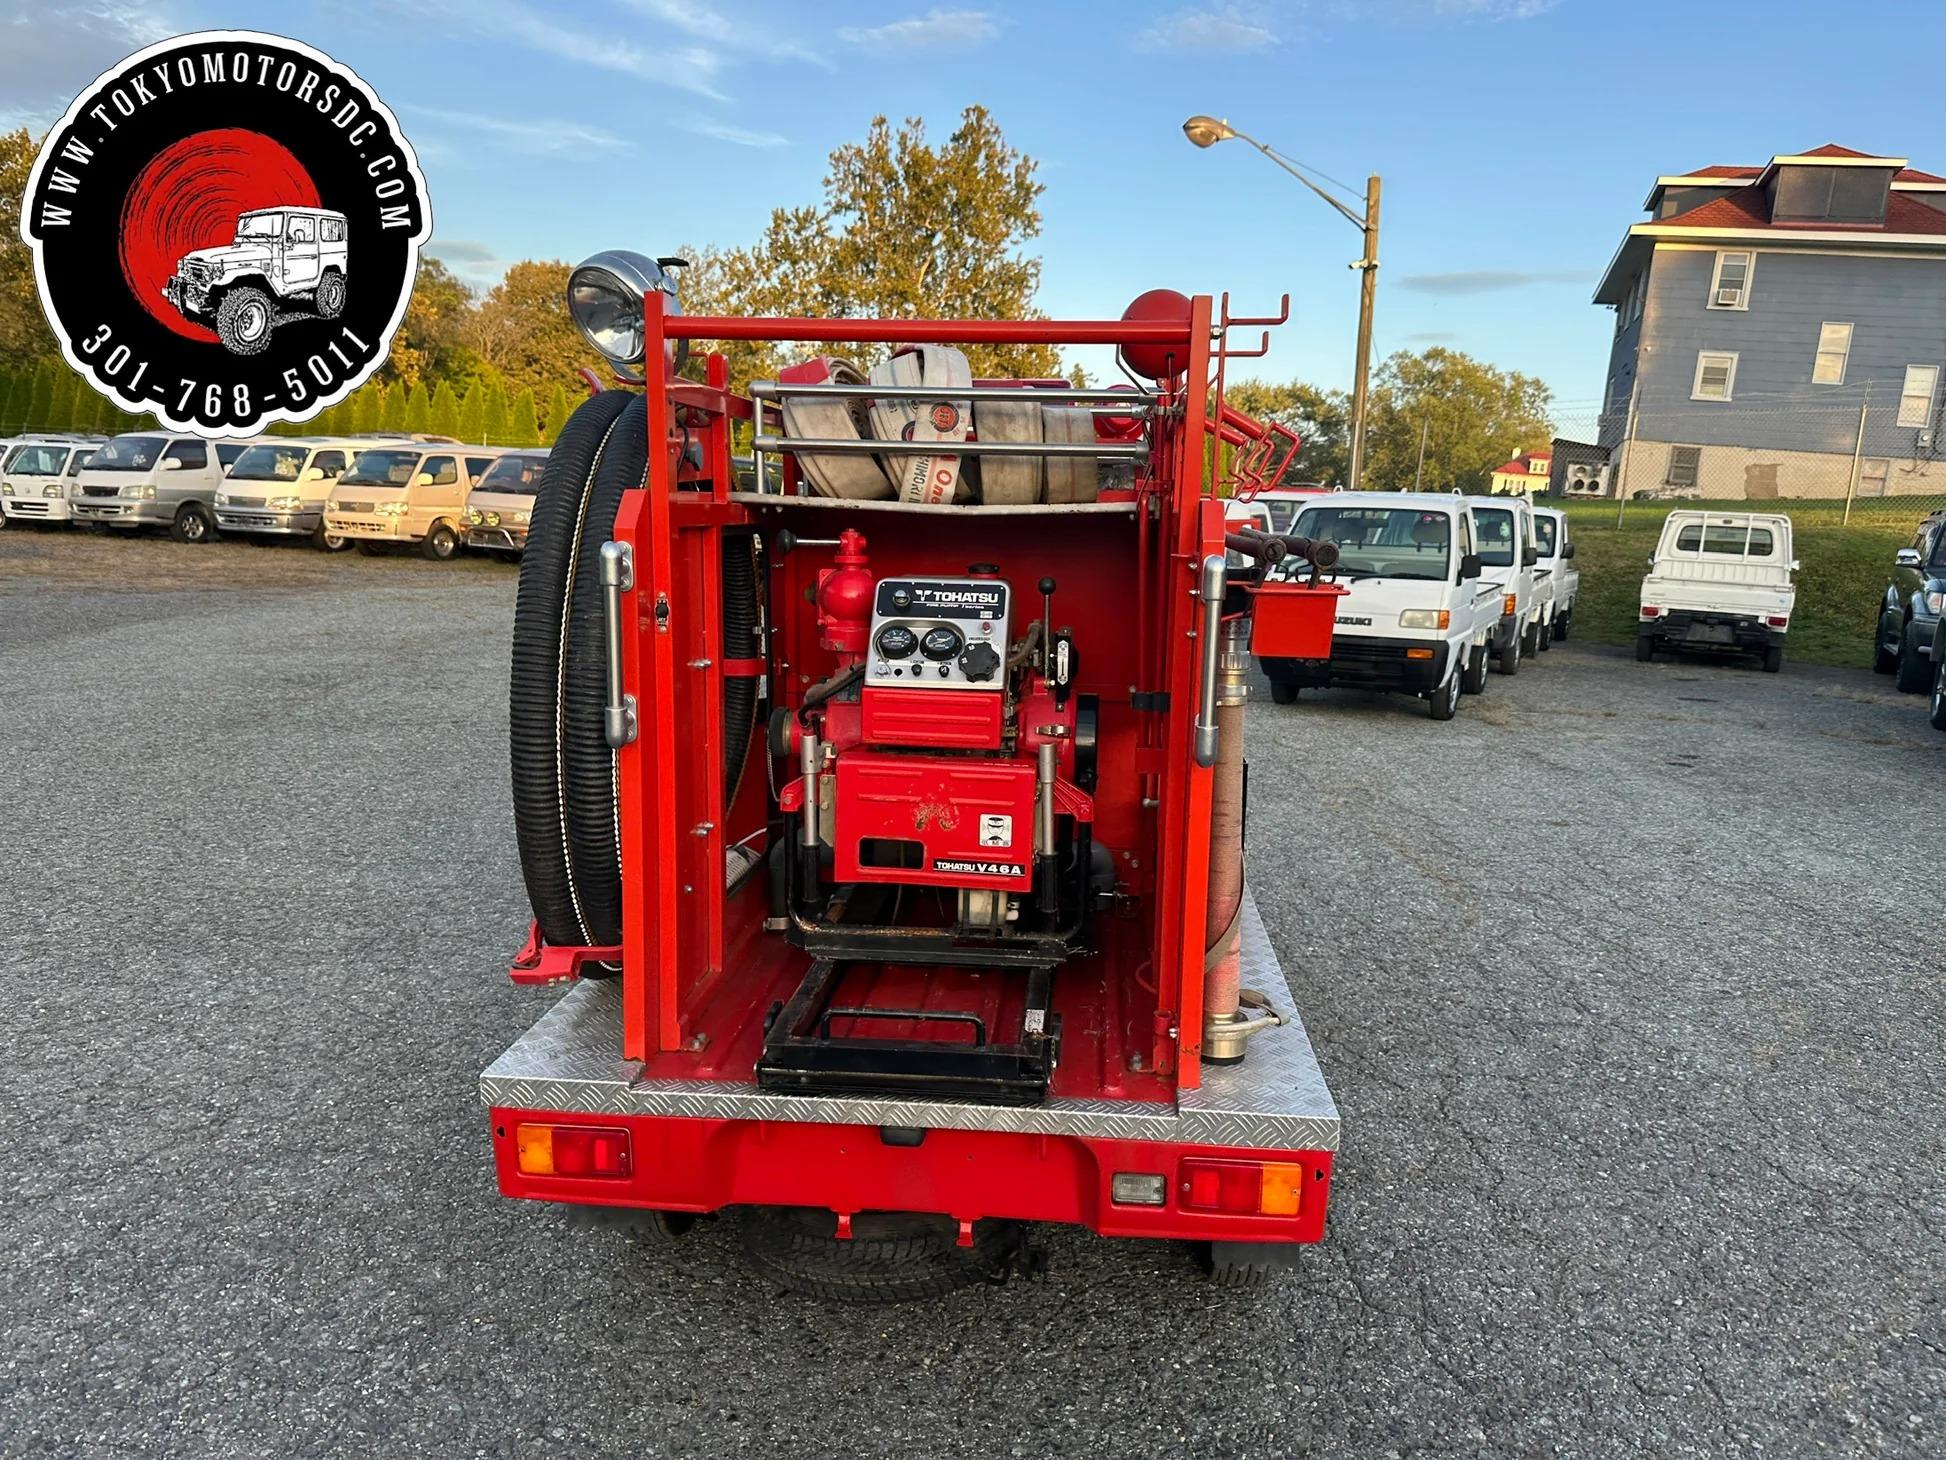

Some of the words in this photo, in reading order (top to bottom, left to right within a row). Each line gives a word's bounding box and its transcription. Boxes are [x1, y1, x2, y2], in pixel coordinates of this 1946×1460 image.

[910, 456, 931, 496] HIMORI
[931, 469, 953, 504] One
[933, 591, 999, 603] TOHATSU
[1334, 616, 1373, 626] UZUKI
[936, 862, 976, 871] TOHATSU
[977, 863, 1022, 874] V46A
